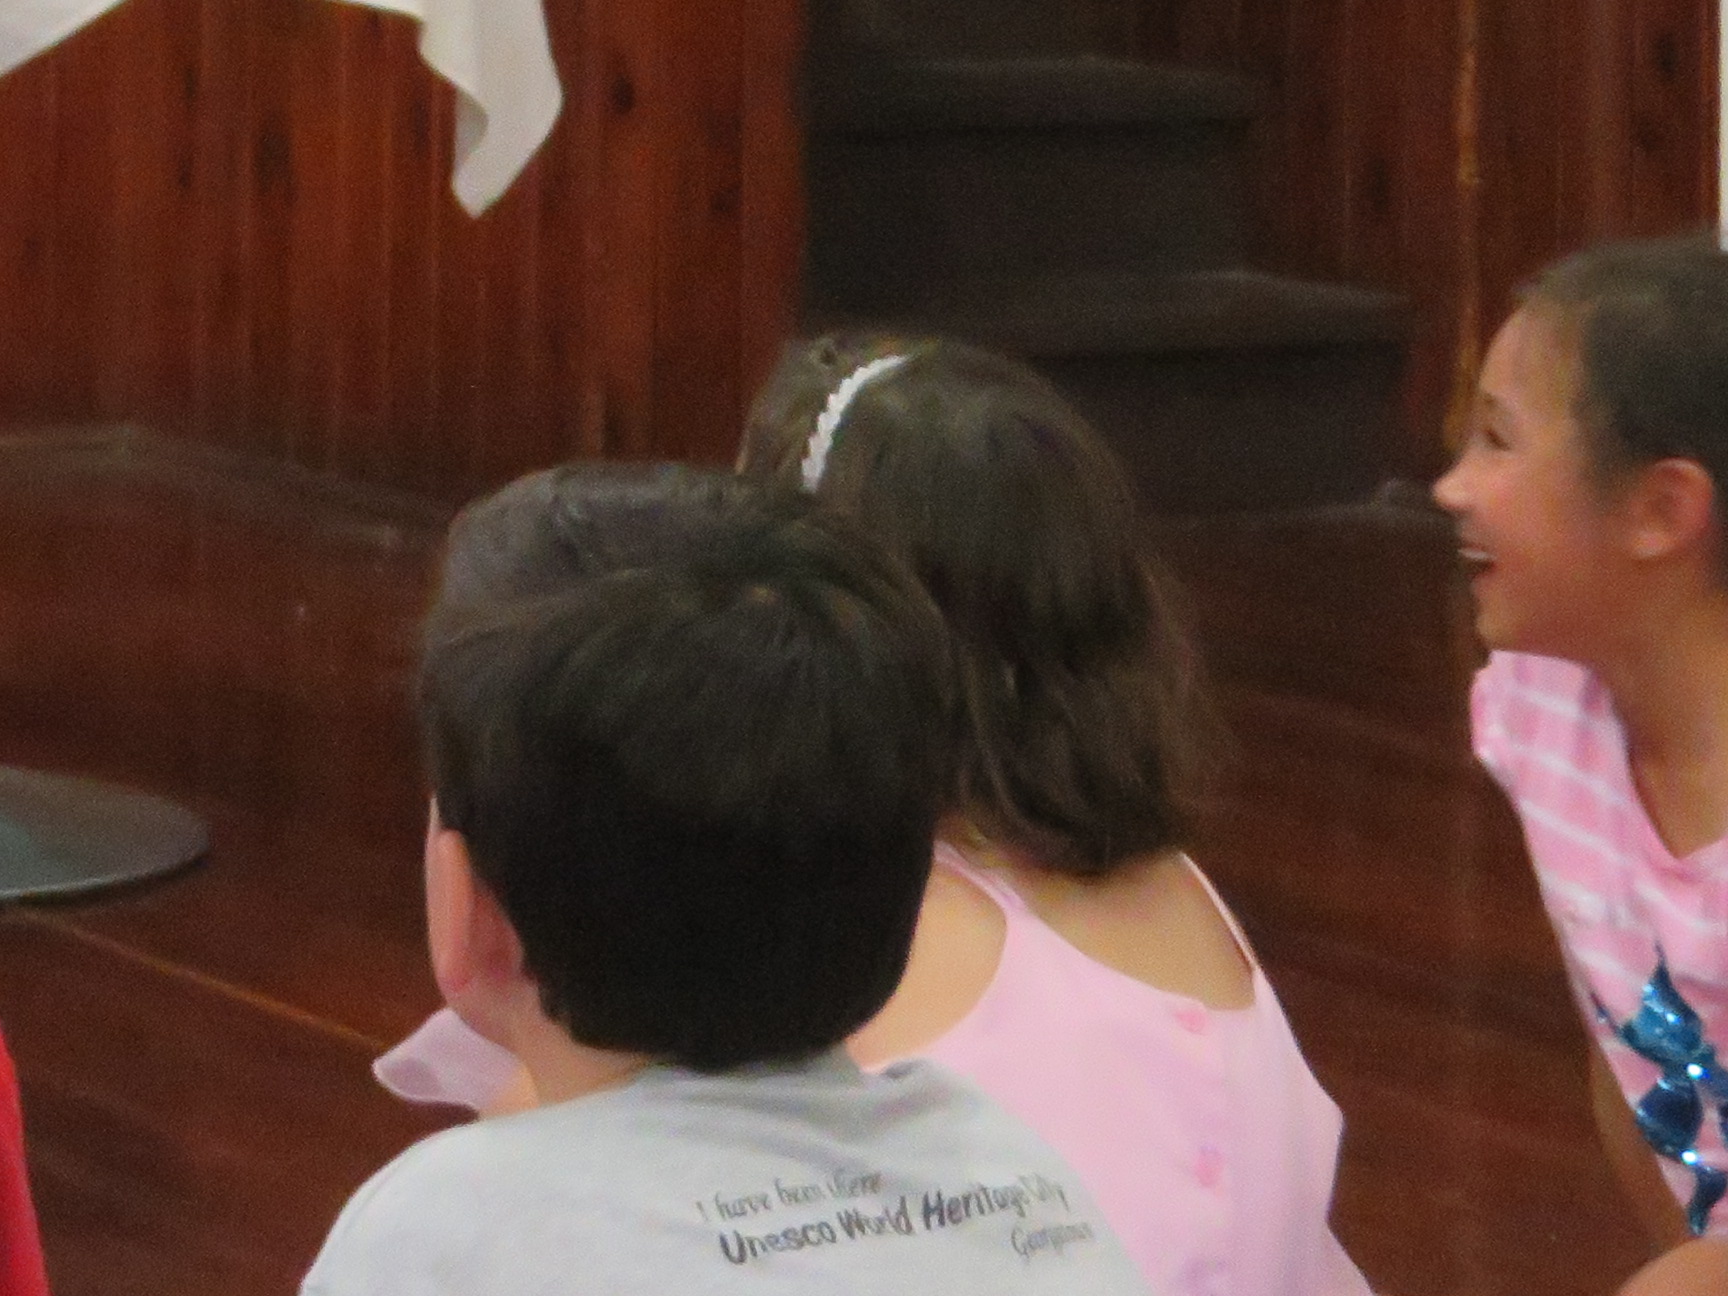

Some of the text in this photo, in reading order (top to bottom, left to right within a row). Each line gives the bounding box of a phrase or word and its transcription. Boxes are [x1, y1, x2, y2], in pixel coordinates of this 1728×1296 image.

[719, 1228, 837, 1265] Unesco
[837, 1195, 913, 1236] World
[922, 1181, 1030, 1231] Heritage
